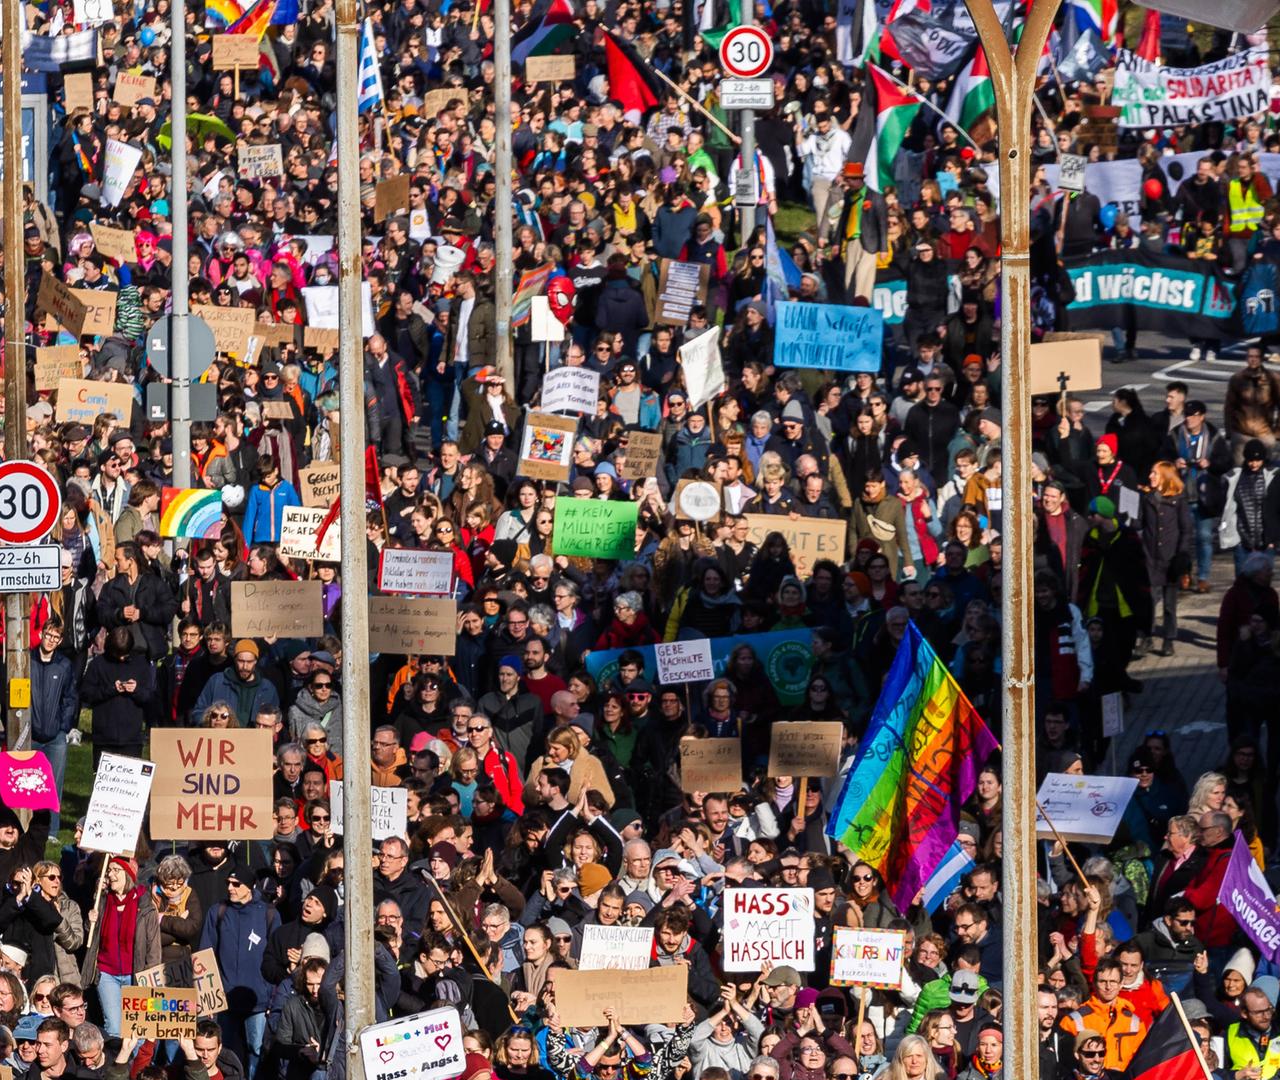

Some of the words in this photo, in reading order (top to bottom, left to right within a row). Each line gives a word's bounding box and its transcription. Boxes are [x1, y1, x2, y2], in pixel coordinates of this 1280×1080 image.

[732, 42, 760, 63] 30
[1097, 268, 1195, 307] wächst
[657, 645, 683, 657] GEBE
[662, 668, 711, 681] GESCHICHTE
[176, 737, 235, 767] WIR
[181, 773, 240, 795] SIND
[176, 802, 257, 830] MEHR
[734, 893, 790, 916] HASS
[744, 918, 801, 938] MACHT
[144, 1012, 167, 1023] kein
[169, 1013, 197, 1024] Platz
[424, 1021, 449, 1035] Mut
[156, 1023, 196, 1038] braun
[421, 1054, 459, 1072] Angst
